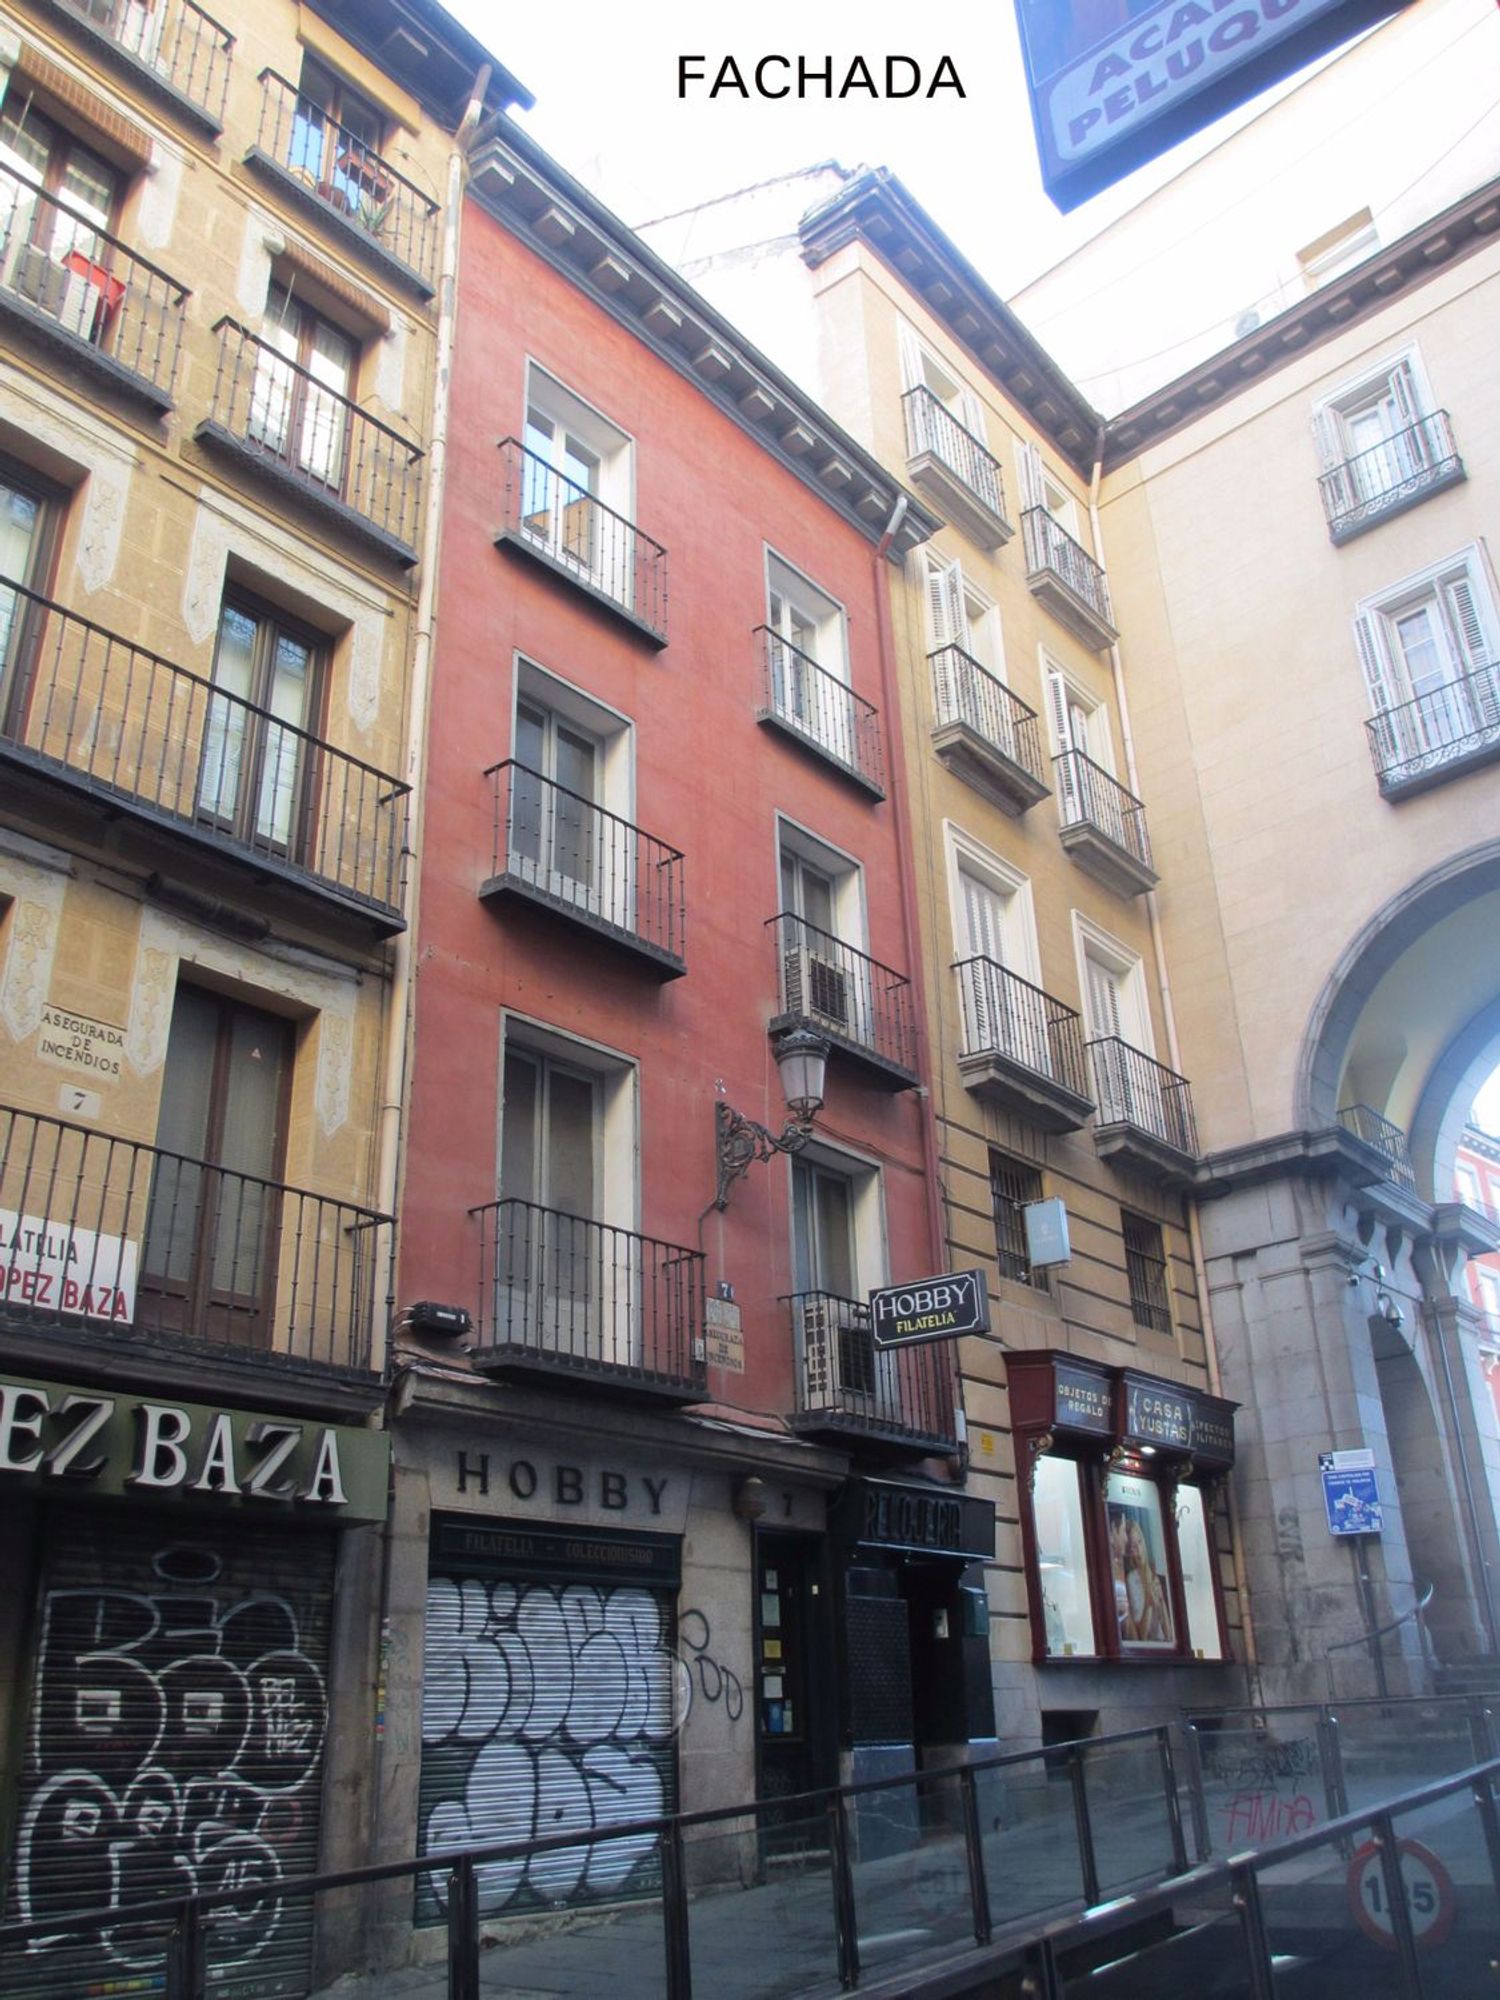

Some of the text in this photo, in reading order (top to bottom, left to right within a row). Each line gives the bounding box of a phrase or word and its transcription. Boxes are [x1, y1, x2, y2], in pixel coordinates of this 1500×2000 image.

[1088, 0, 1234, 97] ACA
[41, 1011, 125, 1048] ASEGURADA
[72, 1035, 92, 1052] DE
[41, 1039, 120, 1075] INCENDIOS
[73, 1091, 87, 1110] 7
[63, 1279, 128, 1320] BAZA
[879, 1281, 970, 1320] HOBBY
[1058, 1384, 1098, 1404] OBJETOS
[1067, 1399, 1104, 1417] REGALO
[1142, 1396, 1183, 1422] CASA
[1138, 1415, 1188, 1441] YUSTAS
[128, 1403, 349, 1504] BAZA
[456, 1450, 668, 1516] HOBBY
[781, 1493, 794, 1517] 7
